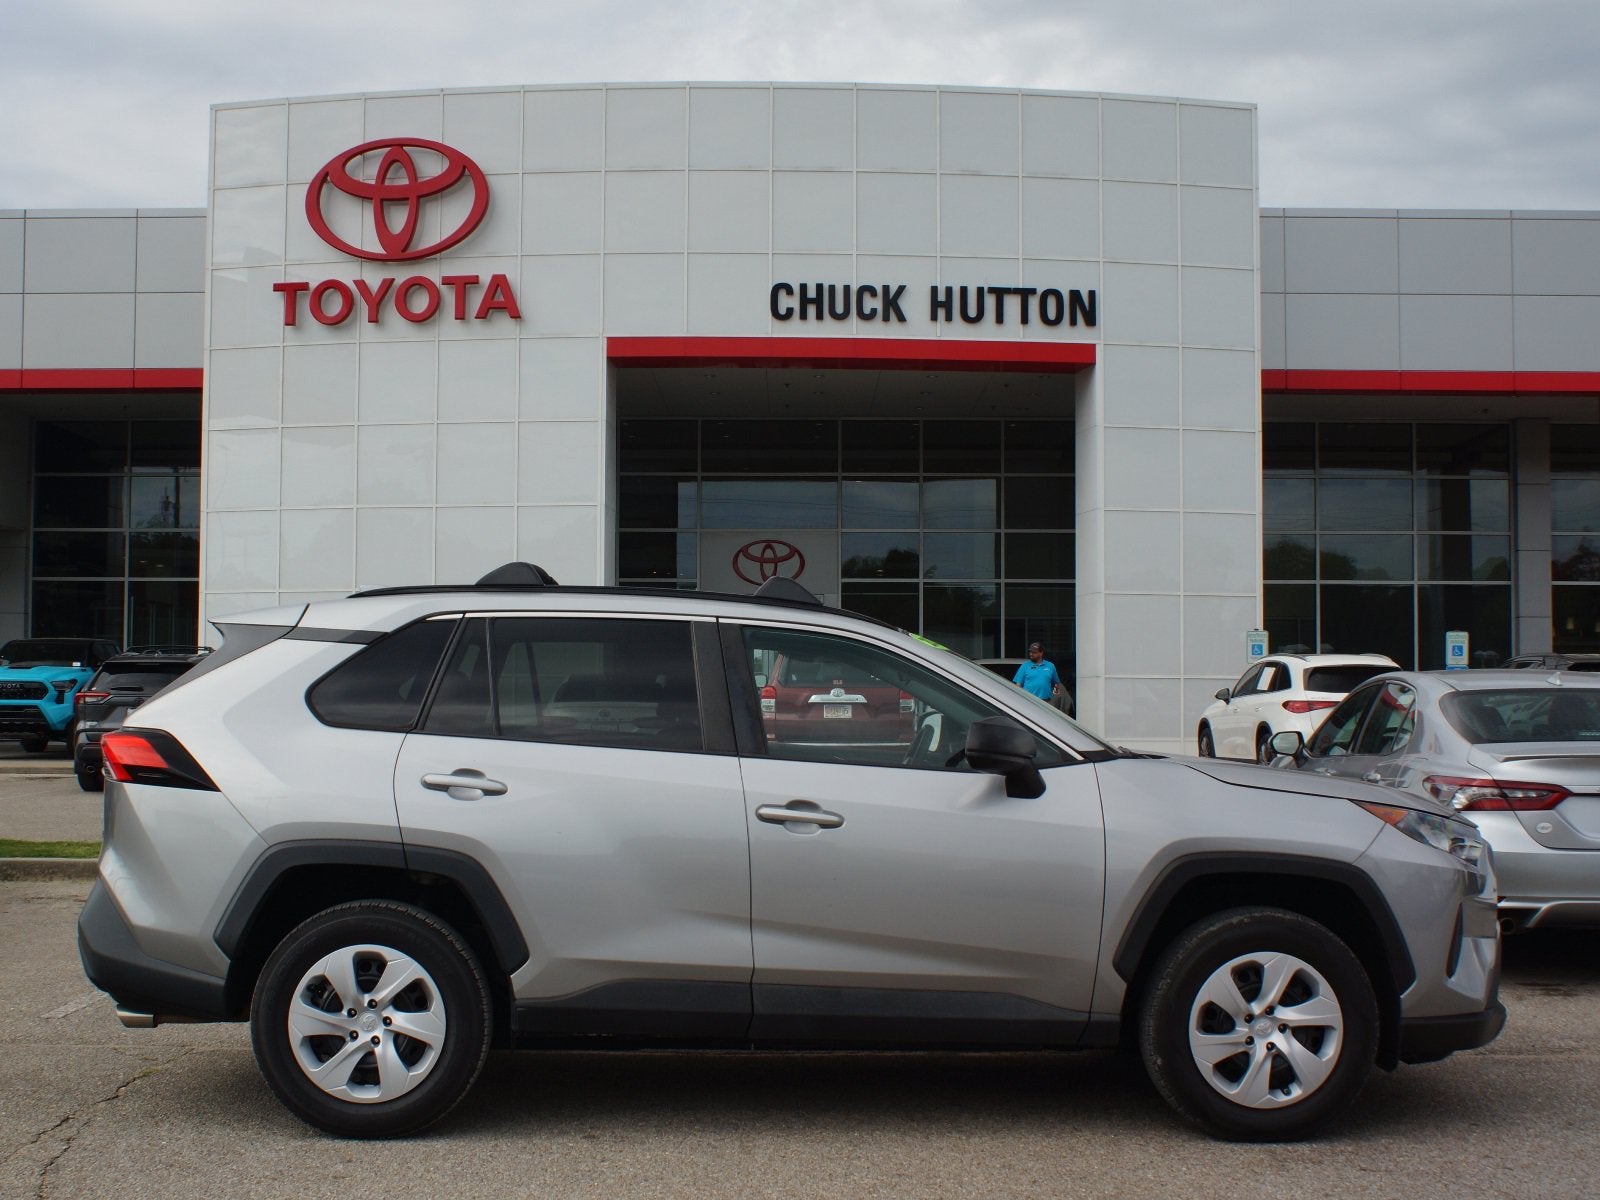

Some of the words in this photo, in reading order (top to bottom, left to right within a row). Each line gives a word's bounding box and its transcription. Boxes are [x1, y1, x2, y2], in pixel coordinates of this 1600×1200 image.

[273, 274, 522, 326] TOYOTA
[770, 282, 907, 322] CHUCK
[930, 286, 1096, 327] HUTTON
